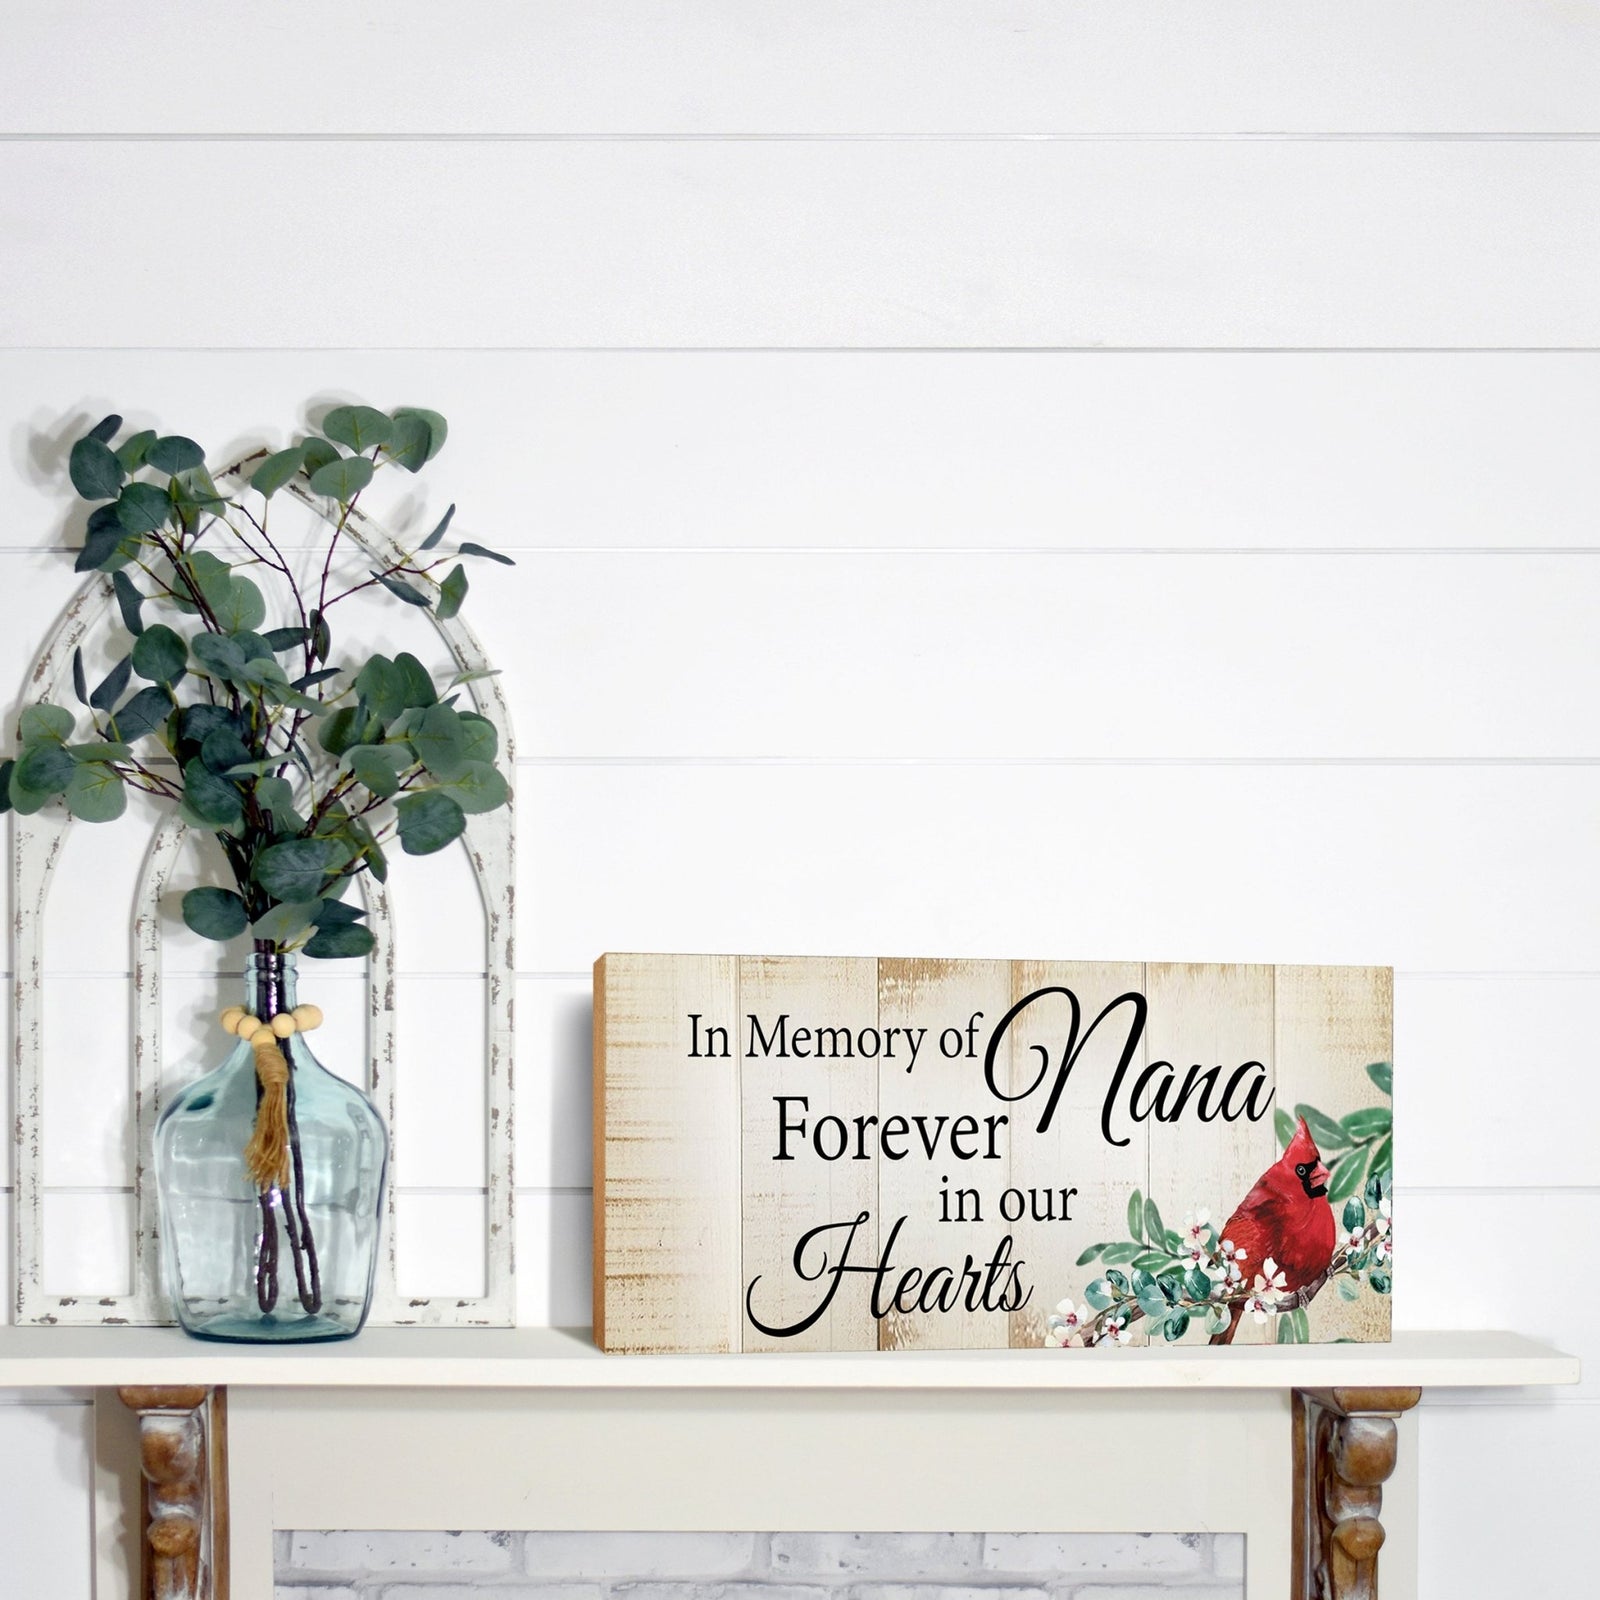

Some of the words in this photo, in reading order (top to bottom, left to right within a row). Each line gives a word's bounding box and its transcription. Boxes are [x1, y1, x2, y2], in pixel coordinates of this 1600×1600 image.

[687, 1014, 732, 1058] In
[745, 1014, 928, 1074] Memory
[939, 1012, 984, 1058] of
[984, 986, 1276, 1147] Nana
[772, 1096, 1009, 1161] Forever
[939, 1175, 984, 1222] in
[999, 1188, 1078, 1222] our
[746, 1210, 1034, 1338] Hearts
